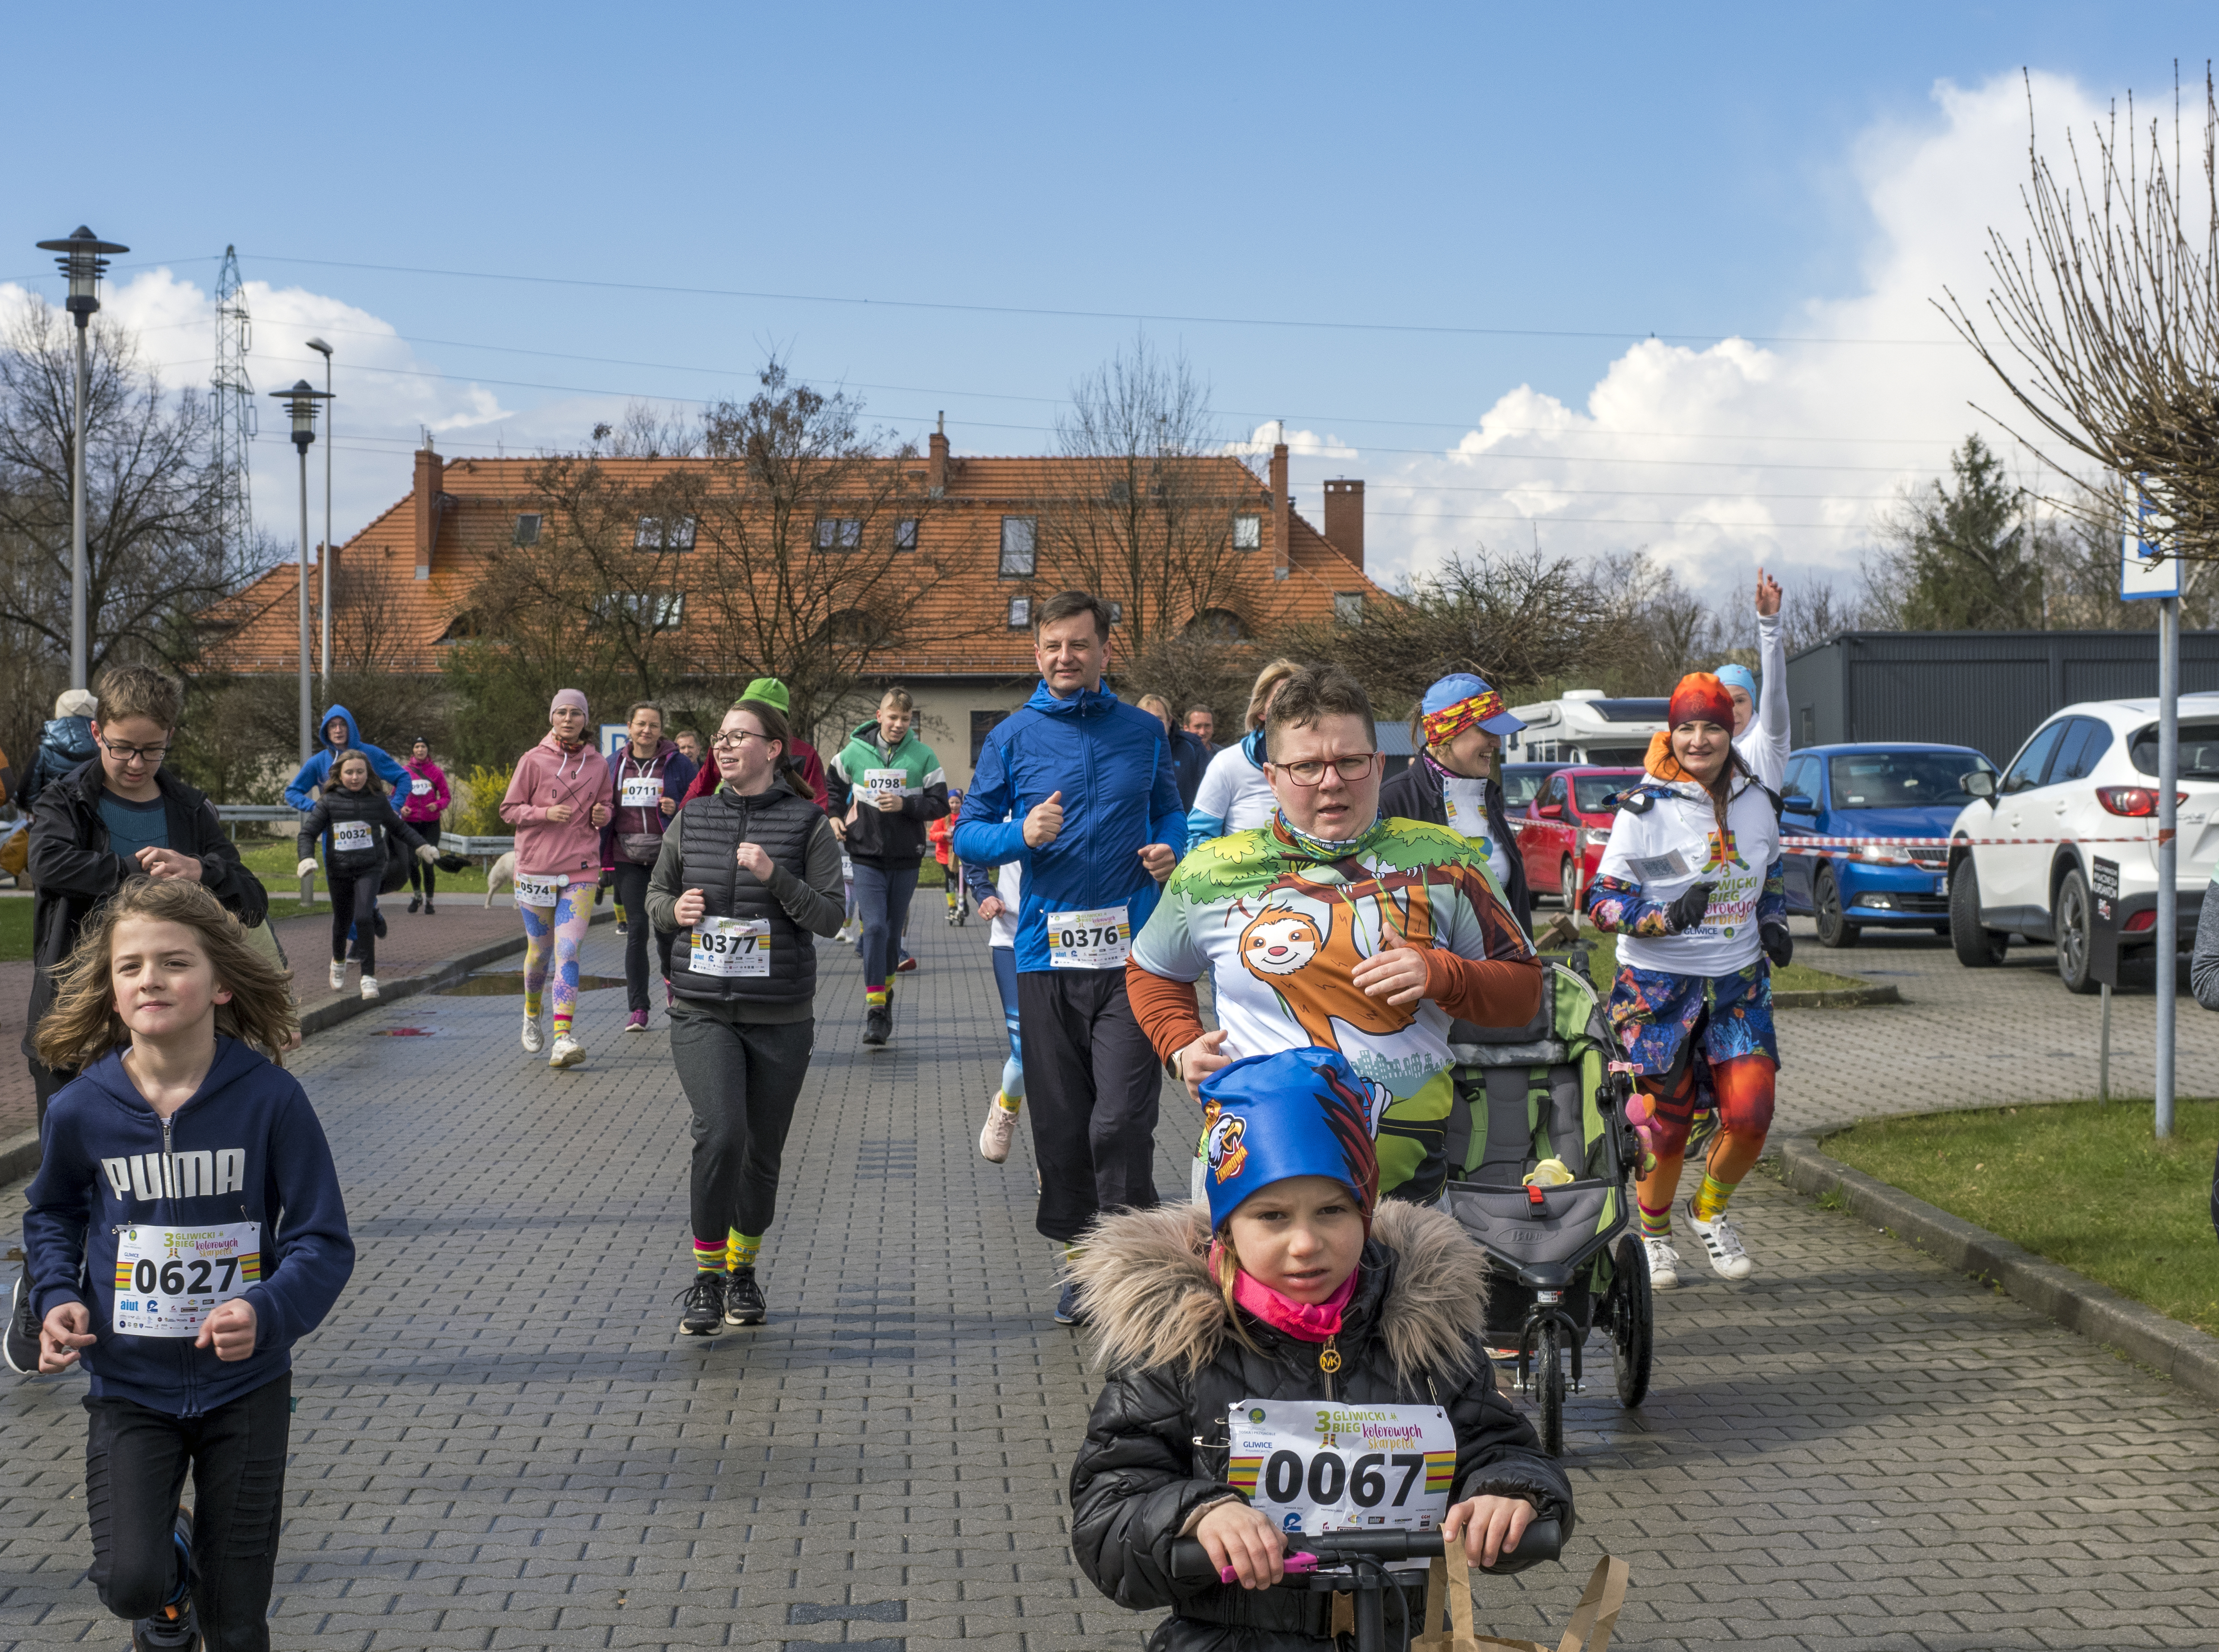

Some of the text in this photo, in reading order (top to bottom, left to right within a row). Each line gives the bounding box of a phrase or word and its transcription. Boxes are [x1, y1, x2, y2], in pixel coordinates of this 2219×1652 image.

[871, 778, 899, 788] 0798
[629, 786, 656, 796] 0711
[340, 829, 366, 839] 0032
[1722, 864, 1731, 878] 3
[521, 882, 549, 895] 0574
[1709, 891, 1739, 903] BIEG
[1075, 914, 1081, 922] 3
[702, 933, 757, 955] 0377
[1062, 926, 1118, 948] 0376
[101, 1148, 245, 1201] PUMA
[164, 1232, 215, 1248] 3 GLIWICKI
[196, 1238, 238, 1250] kolorowych
[199, 1247, 233, 1258] skarpetek
[135, 1256, 239, 1295] 0627
[120, 1299, 139, 1311] aiut
[1314, 1410, 1386, 1433] 3 GLIWICKI
[1333, 1422, 1423, 1441] BIEG kolorowych
[1369, 1436, 1416, 1452] skarpetek
[1265, 1450, 1424, 1508] 0067
